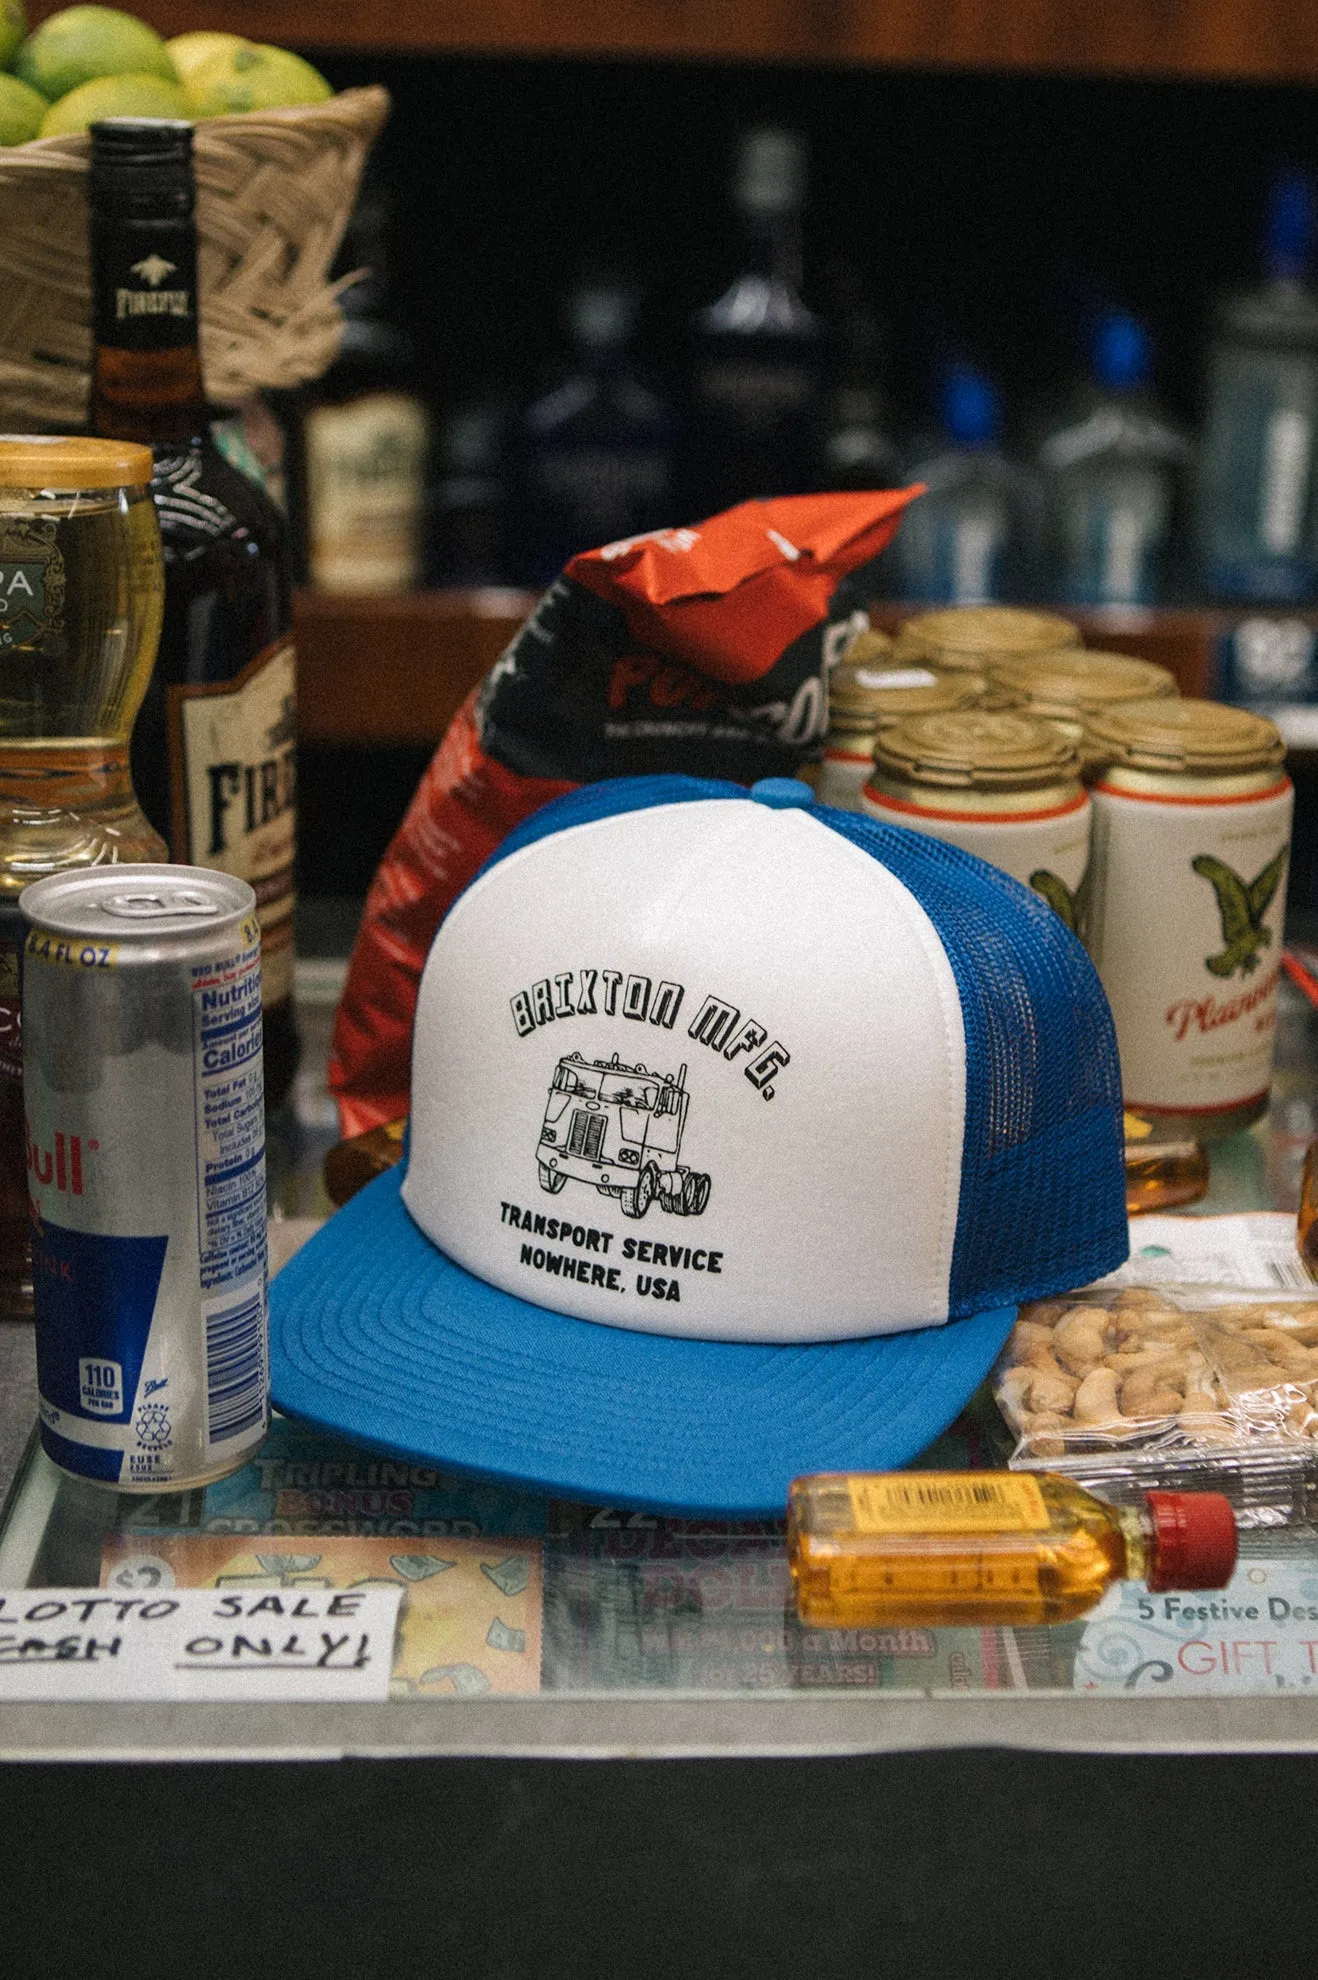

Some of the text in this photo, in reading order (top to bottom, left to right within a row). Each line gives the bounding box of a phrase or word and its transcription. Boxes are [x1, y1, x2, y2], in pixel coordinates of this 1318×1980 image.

[80, 945, 110, 968] OZ
[509, 969, 791, 1102] BRIXTON MFG.
[500, 1201, 724, 1274] TRANSPORT SERVICE
[519, 1243, 681, 1302] NOWHERE, USA
[85, 1364, 115, 1389] 110
[82, 1385, 120, 1401] CALORIES
[254, 1457, 442, 1490] TRIPLING
[276, 1488, 414, 1517] BONUS
[0, 1593, 366, 1624] LOTTO SALE
[1138, 1598, 1155, 1620] 5
[1164, 1598, 1259, 1620] Festive
[185, 1633, 371, 1668] ONLY!
[829, 1628, 933, 1653] Month
[1178, 1640, 1277, 1676] GIFT
